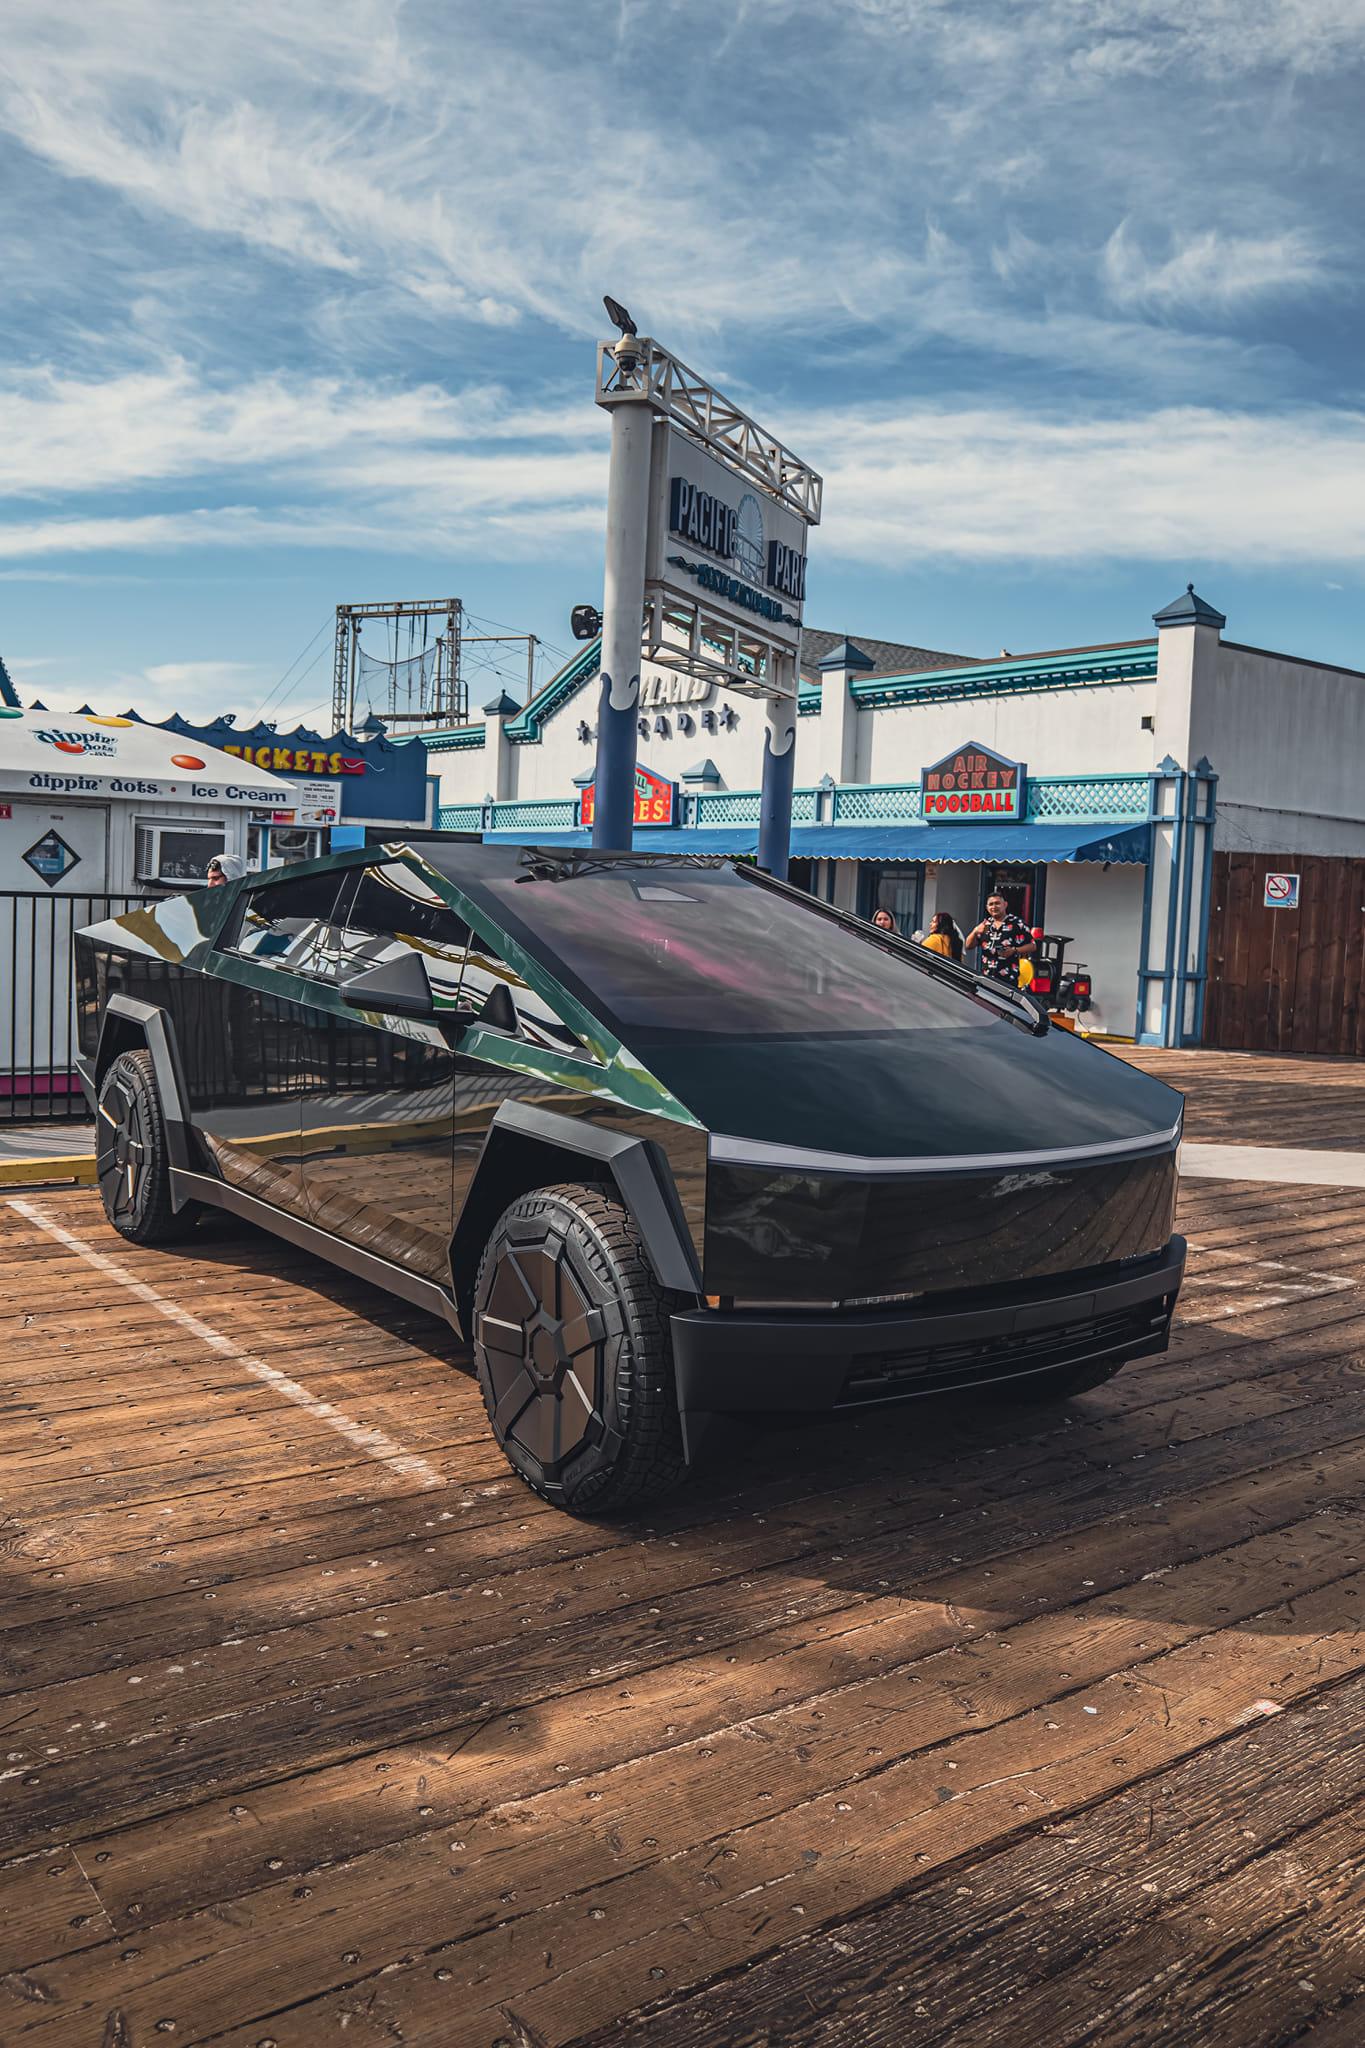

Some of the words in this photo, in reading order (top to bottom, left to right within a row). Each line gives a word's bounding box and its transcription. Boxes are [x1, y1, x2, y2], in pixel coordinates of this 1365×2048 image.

[670, 477, 738, 559] PACIFIC
[767, 540, 808, 601] PARK
[642, 673, 713, 707] LAND
[32, 729, 118, 744] dippin'
[223, 745, 342, 774] TICKETS
[953, 755, 988, 773] AIR
[29, 774, 102, 791] dippin'
[110, 779, 158, 794] dots
[191, 784, 218, 798] Ice
[225, 786, 287, 802] Cream
[927, 770, 1014, 790] HOCKEY
[924, 792, 1014, 813] FOOSBALL
